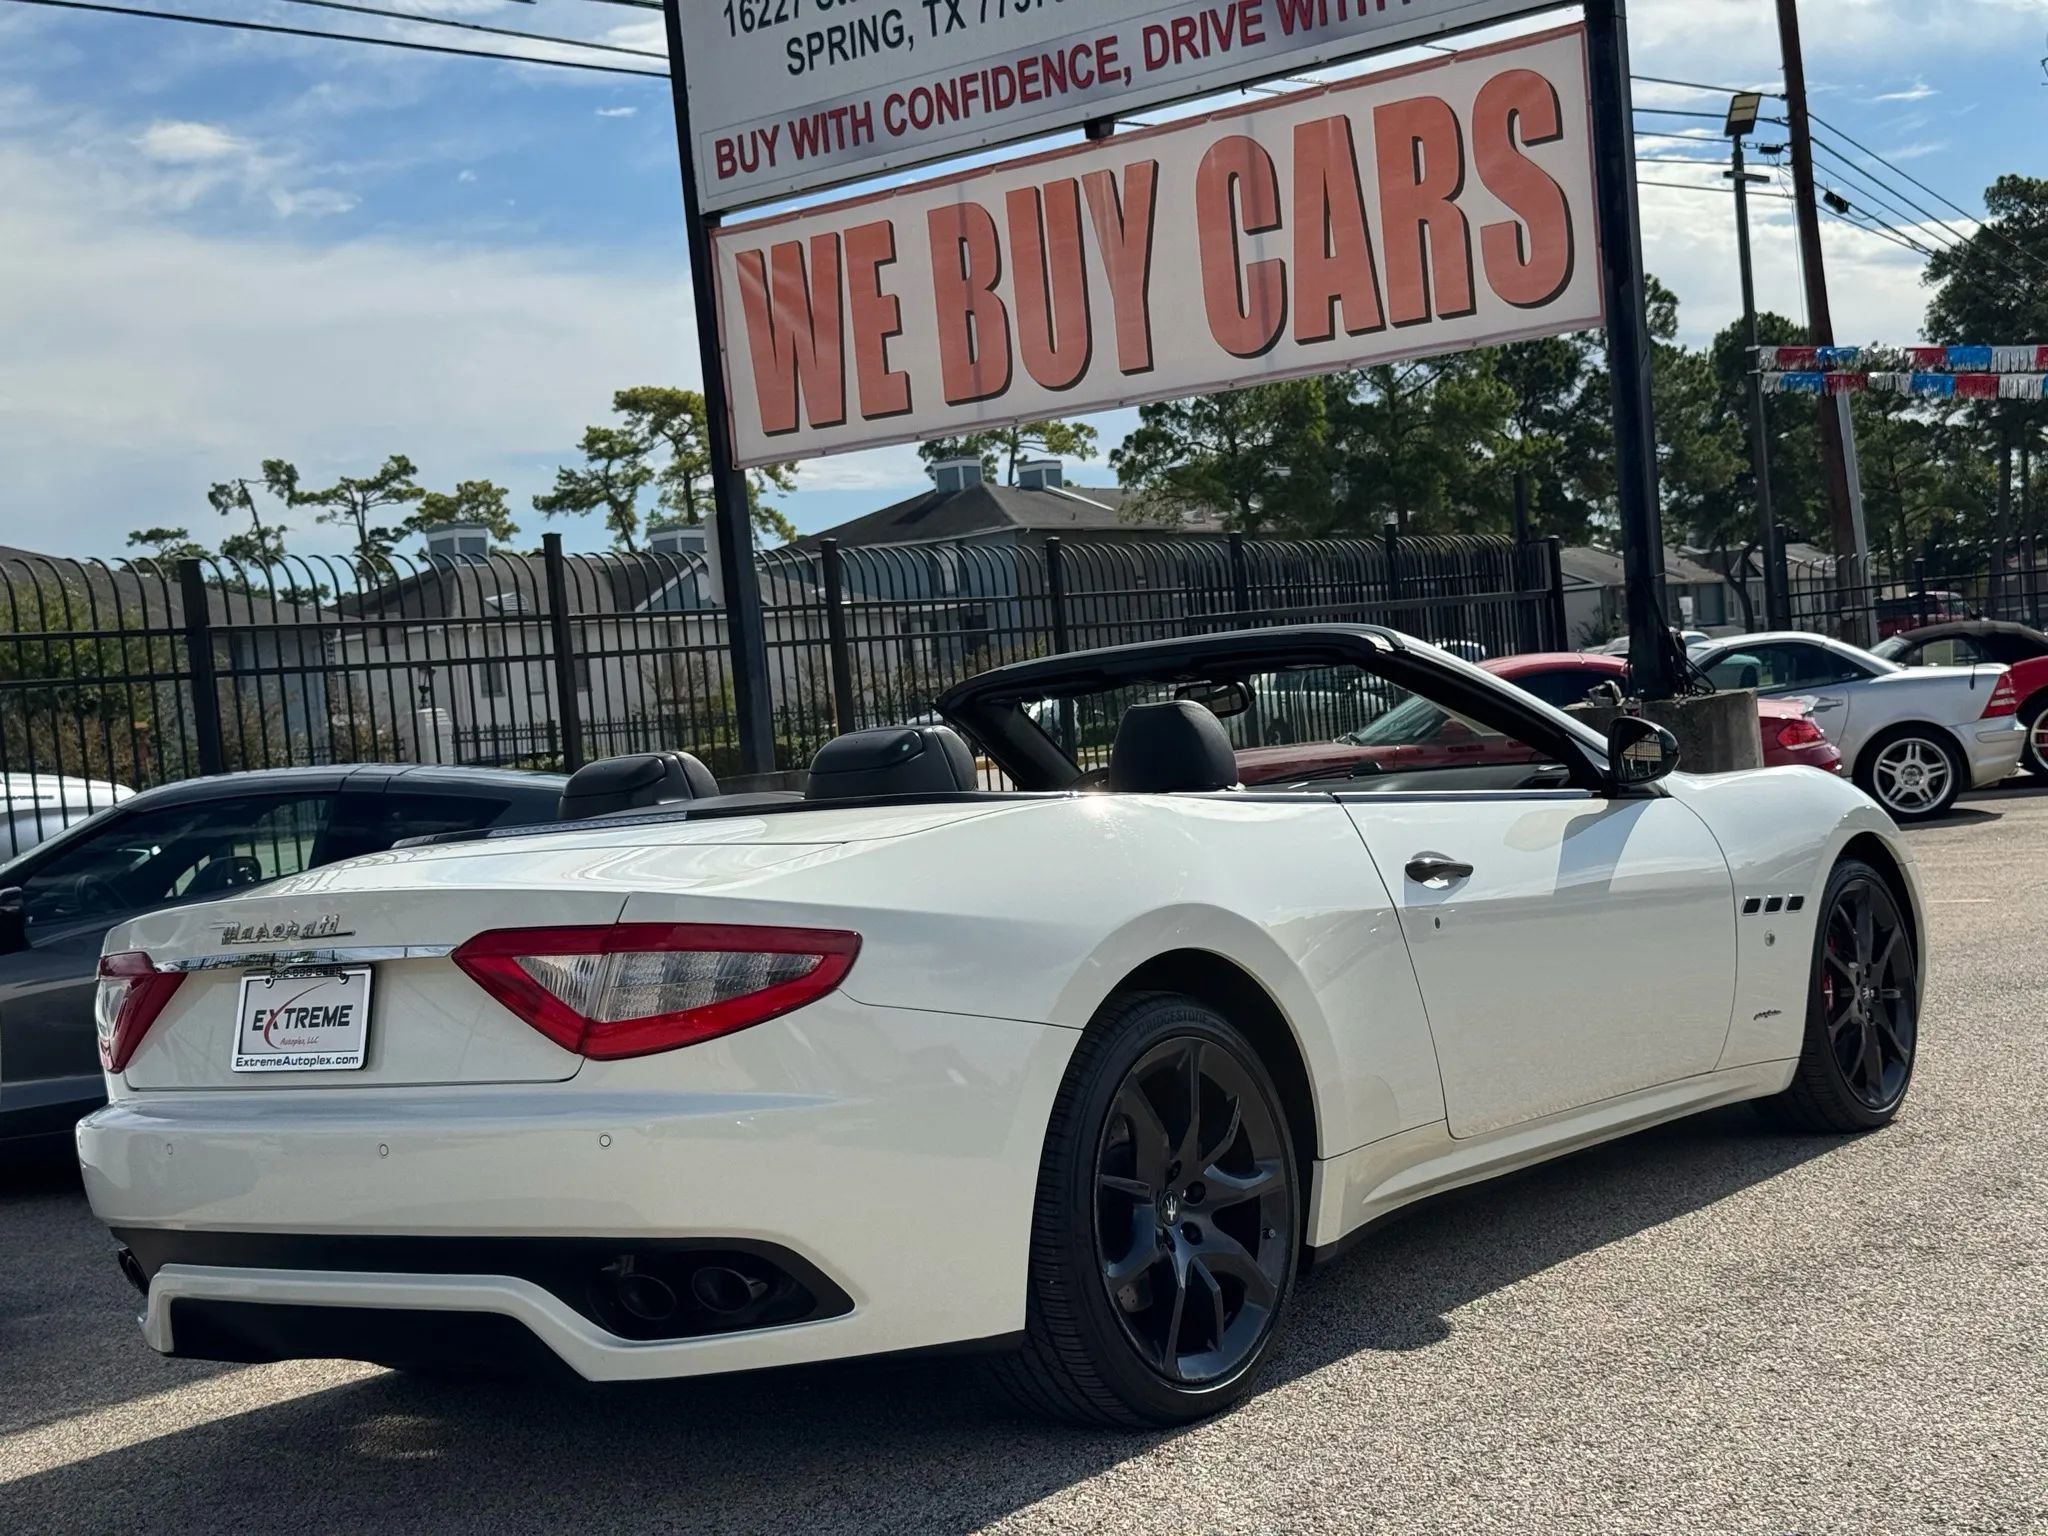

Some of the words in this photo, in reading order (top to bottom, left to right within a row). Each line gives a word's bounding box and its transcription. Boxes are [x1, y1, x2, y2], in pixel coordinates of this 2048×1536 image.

[786, 14, 914, 76] SPRING,
[922, 0, 967, 37] TX
[715, 124, 780, 180] BUY
[789, 101, 875, 160] WITH
[884, 35, 1132, 136] CONFIDENCE,
[1142, 0, 1267, 71] DRIVE
[735, 219, 914, 436] WE
[926, 160, 1158, 405] BUY
[1196, 69, 1574, 359] CARS
[210, 914, 356, 945] Maserati
[252, 1004, 354, 1031] EXTREME
[235, 1055, 359, 1067] ExtremeAutoplex.com
